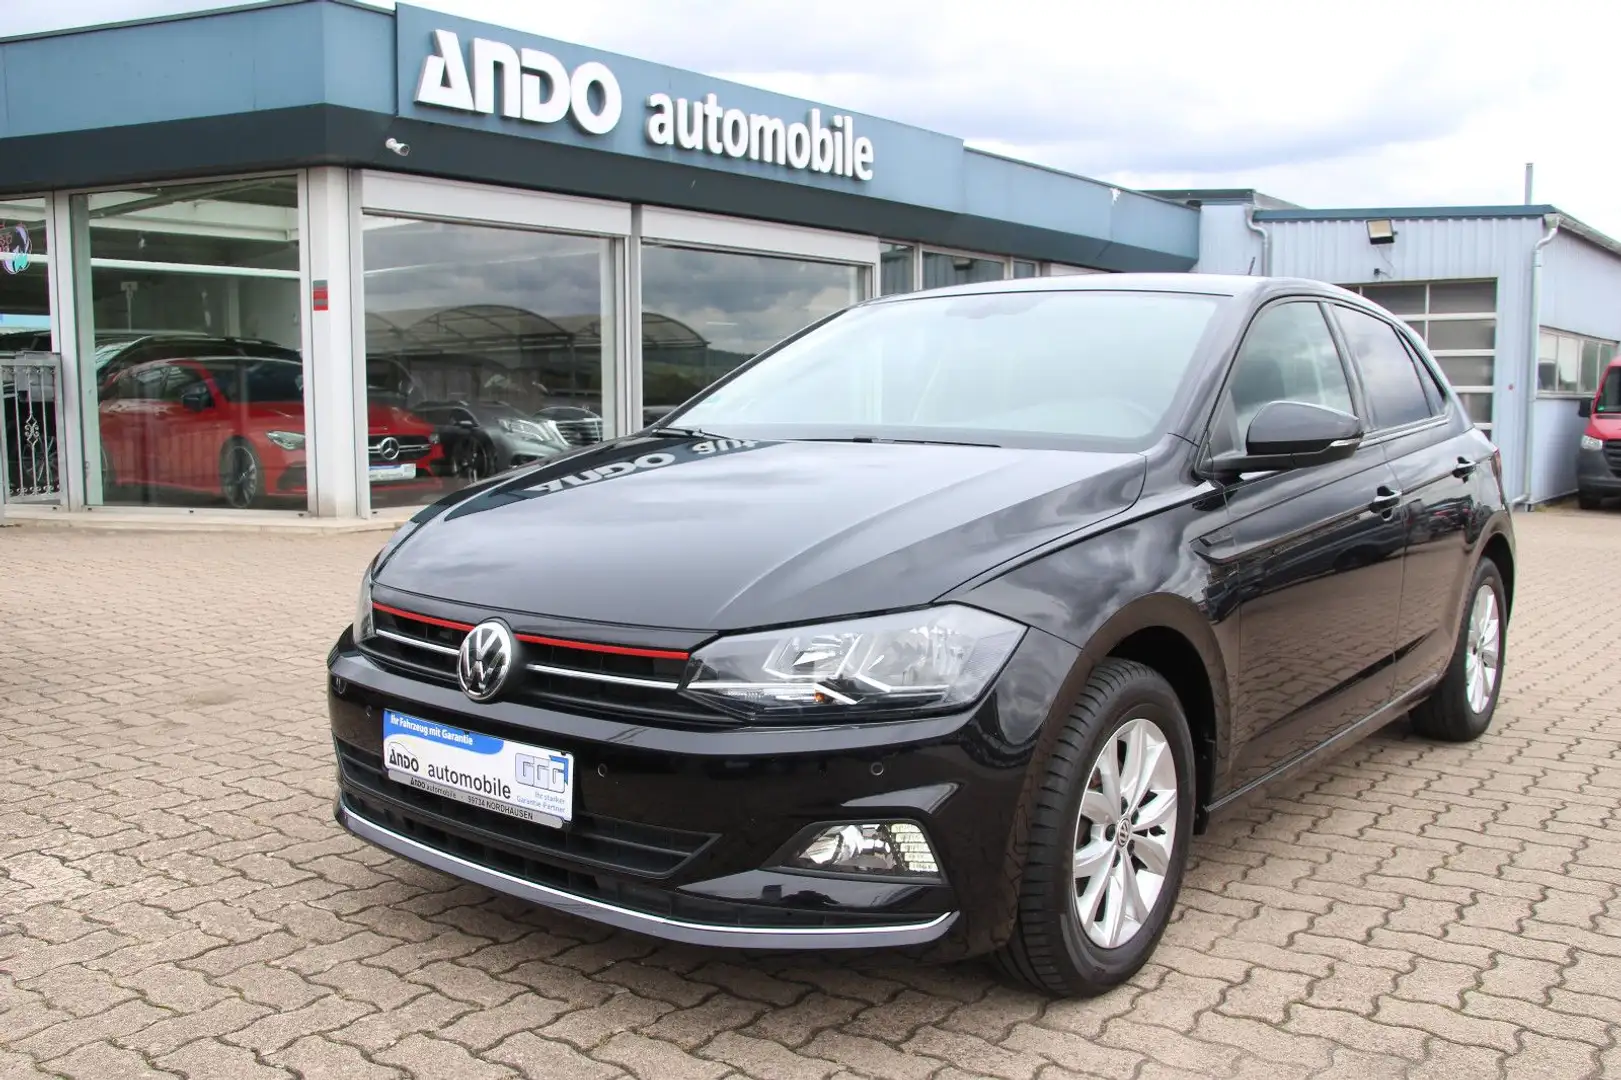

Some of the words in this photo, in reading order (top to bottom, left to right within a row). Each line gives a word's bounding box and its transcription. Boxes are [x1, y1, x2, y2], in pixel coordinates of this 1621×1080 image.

[414, 28, 622, 135] ANDO
[645, 92, 874, 180] automobile
[390, 714, 398, 725] Ihr
[399, 717, 428, 736] Fahrzeug
[429, 727, 440, 737] mit
[441, 729, 473, 745] Garantie
[389, 749, 419, 772] ANDO
[427, 764, 511, 799] automobile
[426, 782, 457, 799] automobile
[486, 800, 533, 820] NORDHAUSEN
